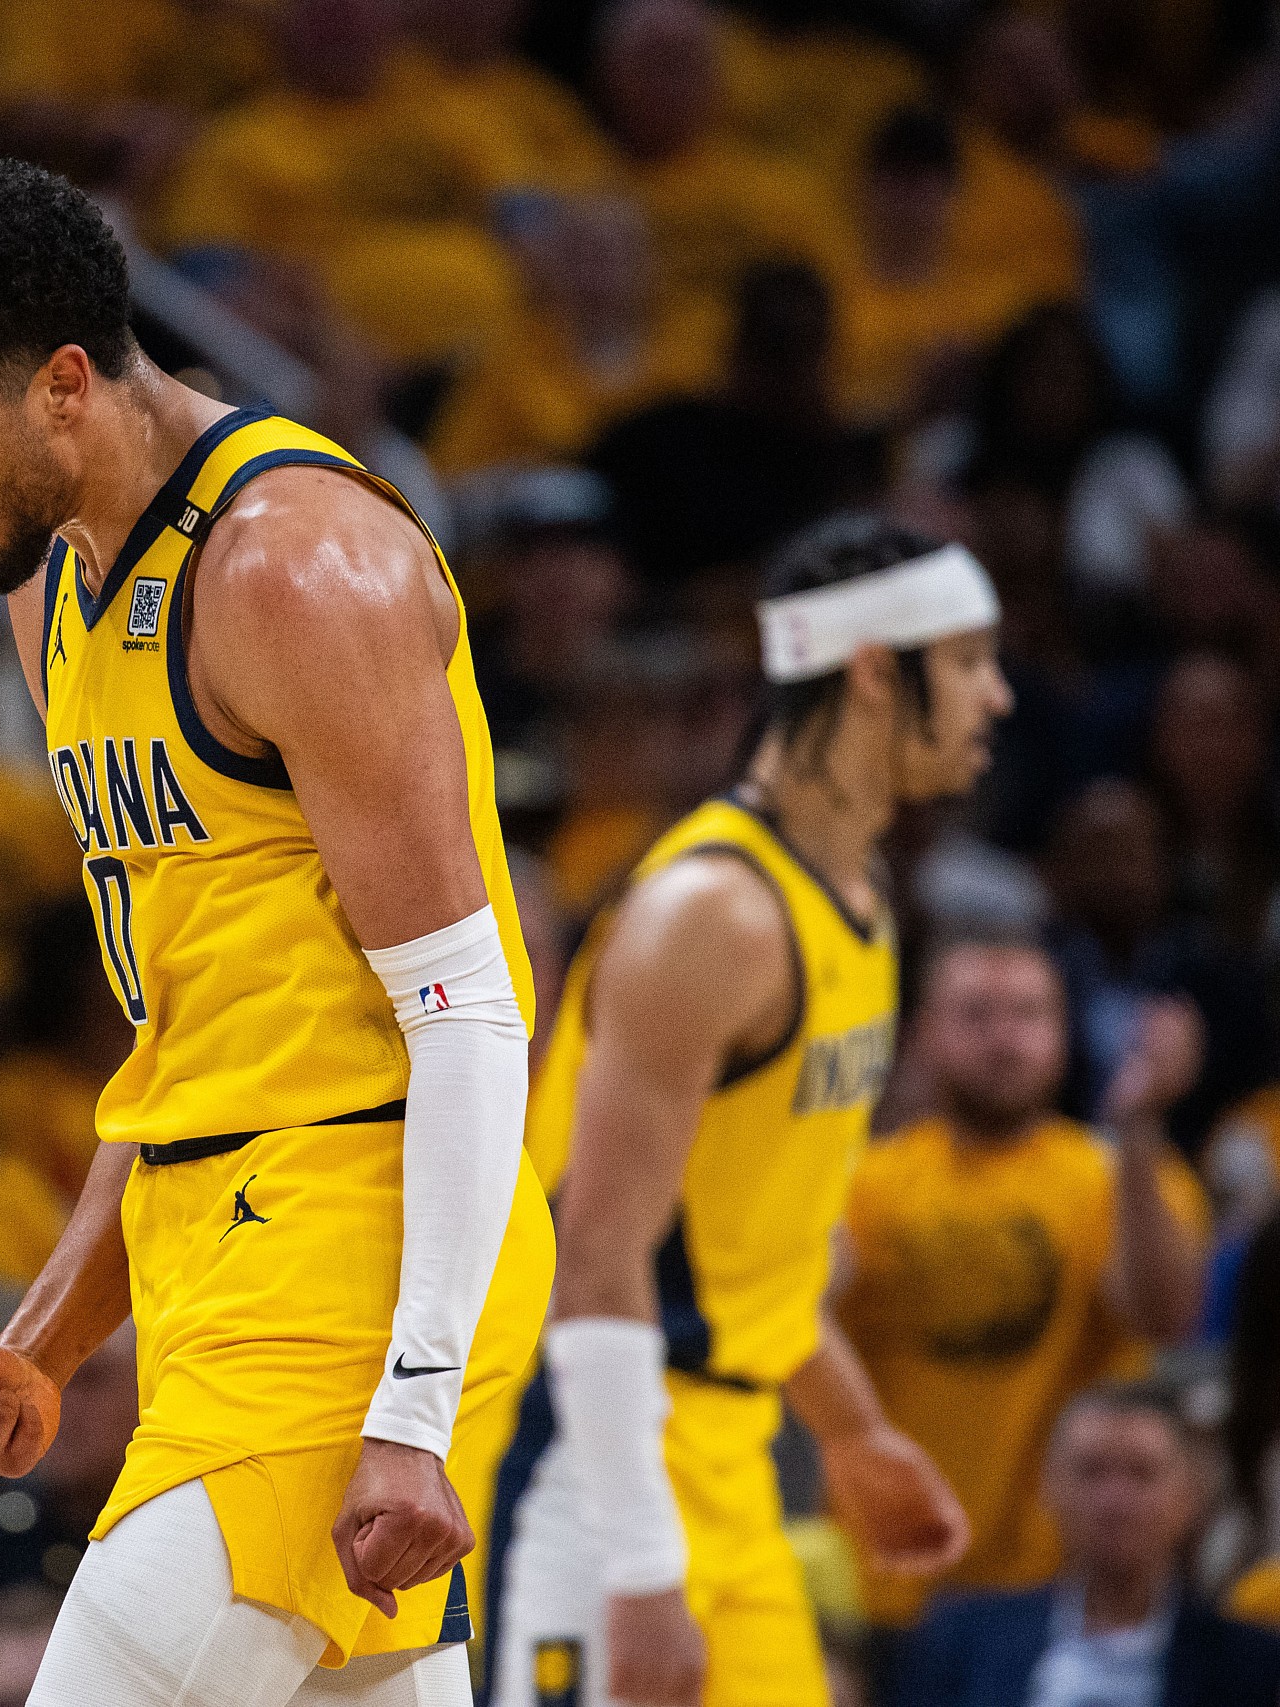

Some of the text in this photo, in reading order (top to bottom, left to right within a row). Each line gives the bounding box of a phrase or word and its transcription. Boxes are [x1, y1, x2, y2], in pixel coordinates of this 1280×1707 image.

[177, 505, 200, 533] 30
[122, 637, 160, 653] spokenote
[83, 855, 149, 1025] 0
